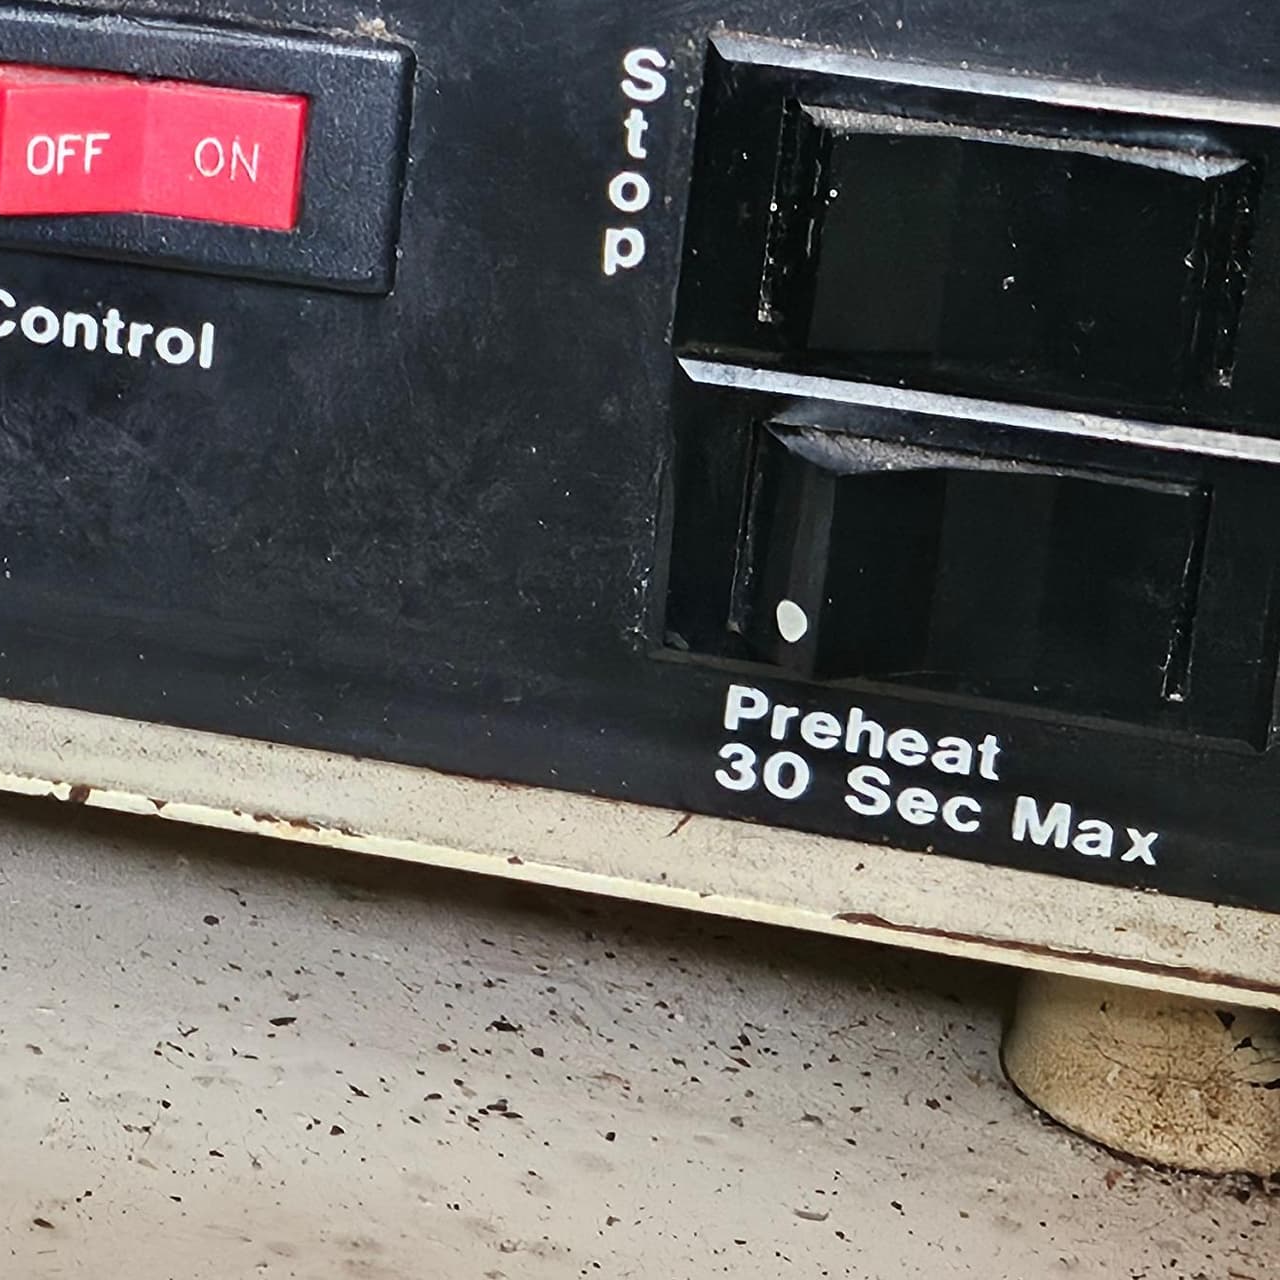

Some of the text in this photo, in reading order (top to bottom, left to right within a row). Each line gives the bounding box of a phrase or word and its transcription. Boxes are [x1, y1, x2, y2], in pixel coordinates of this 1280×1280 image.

[26, 131, 260, 183] OFF ON
[603, 47, 667, 276] Stop
[724, 684, 1001, 782] Preheat
[715, 742, 1159, 866] 30 Sec Max
